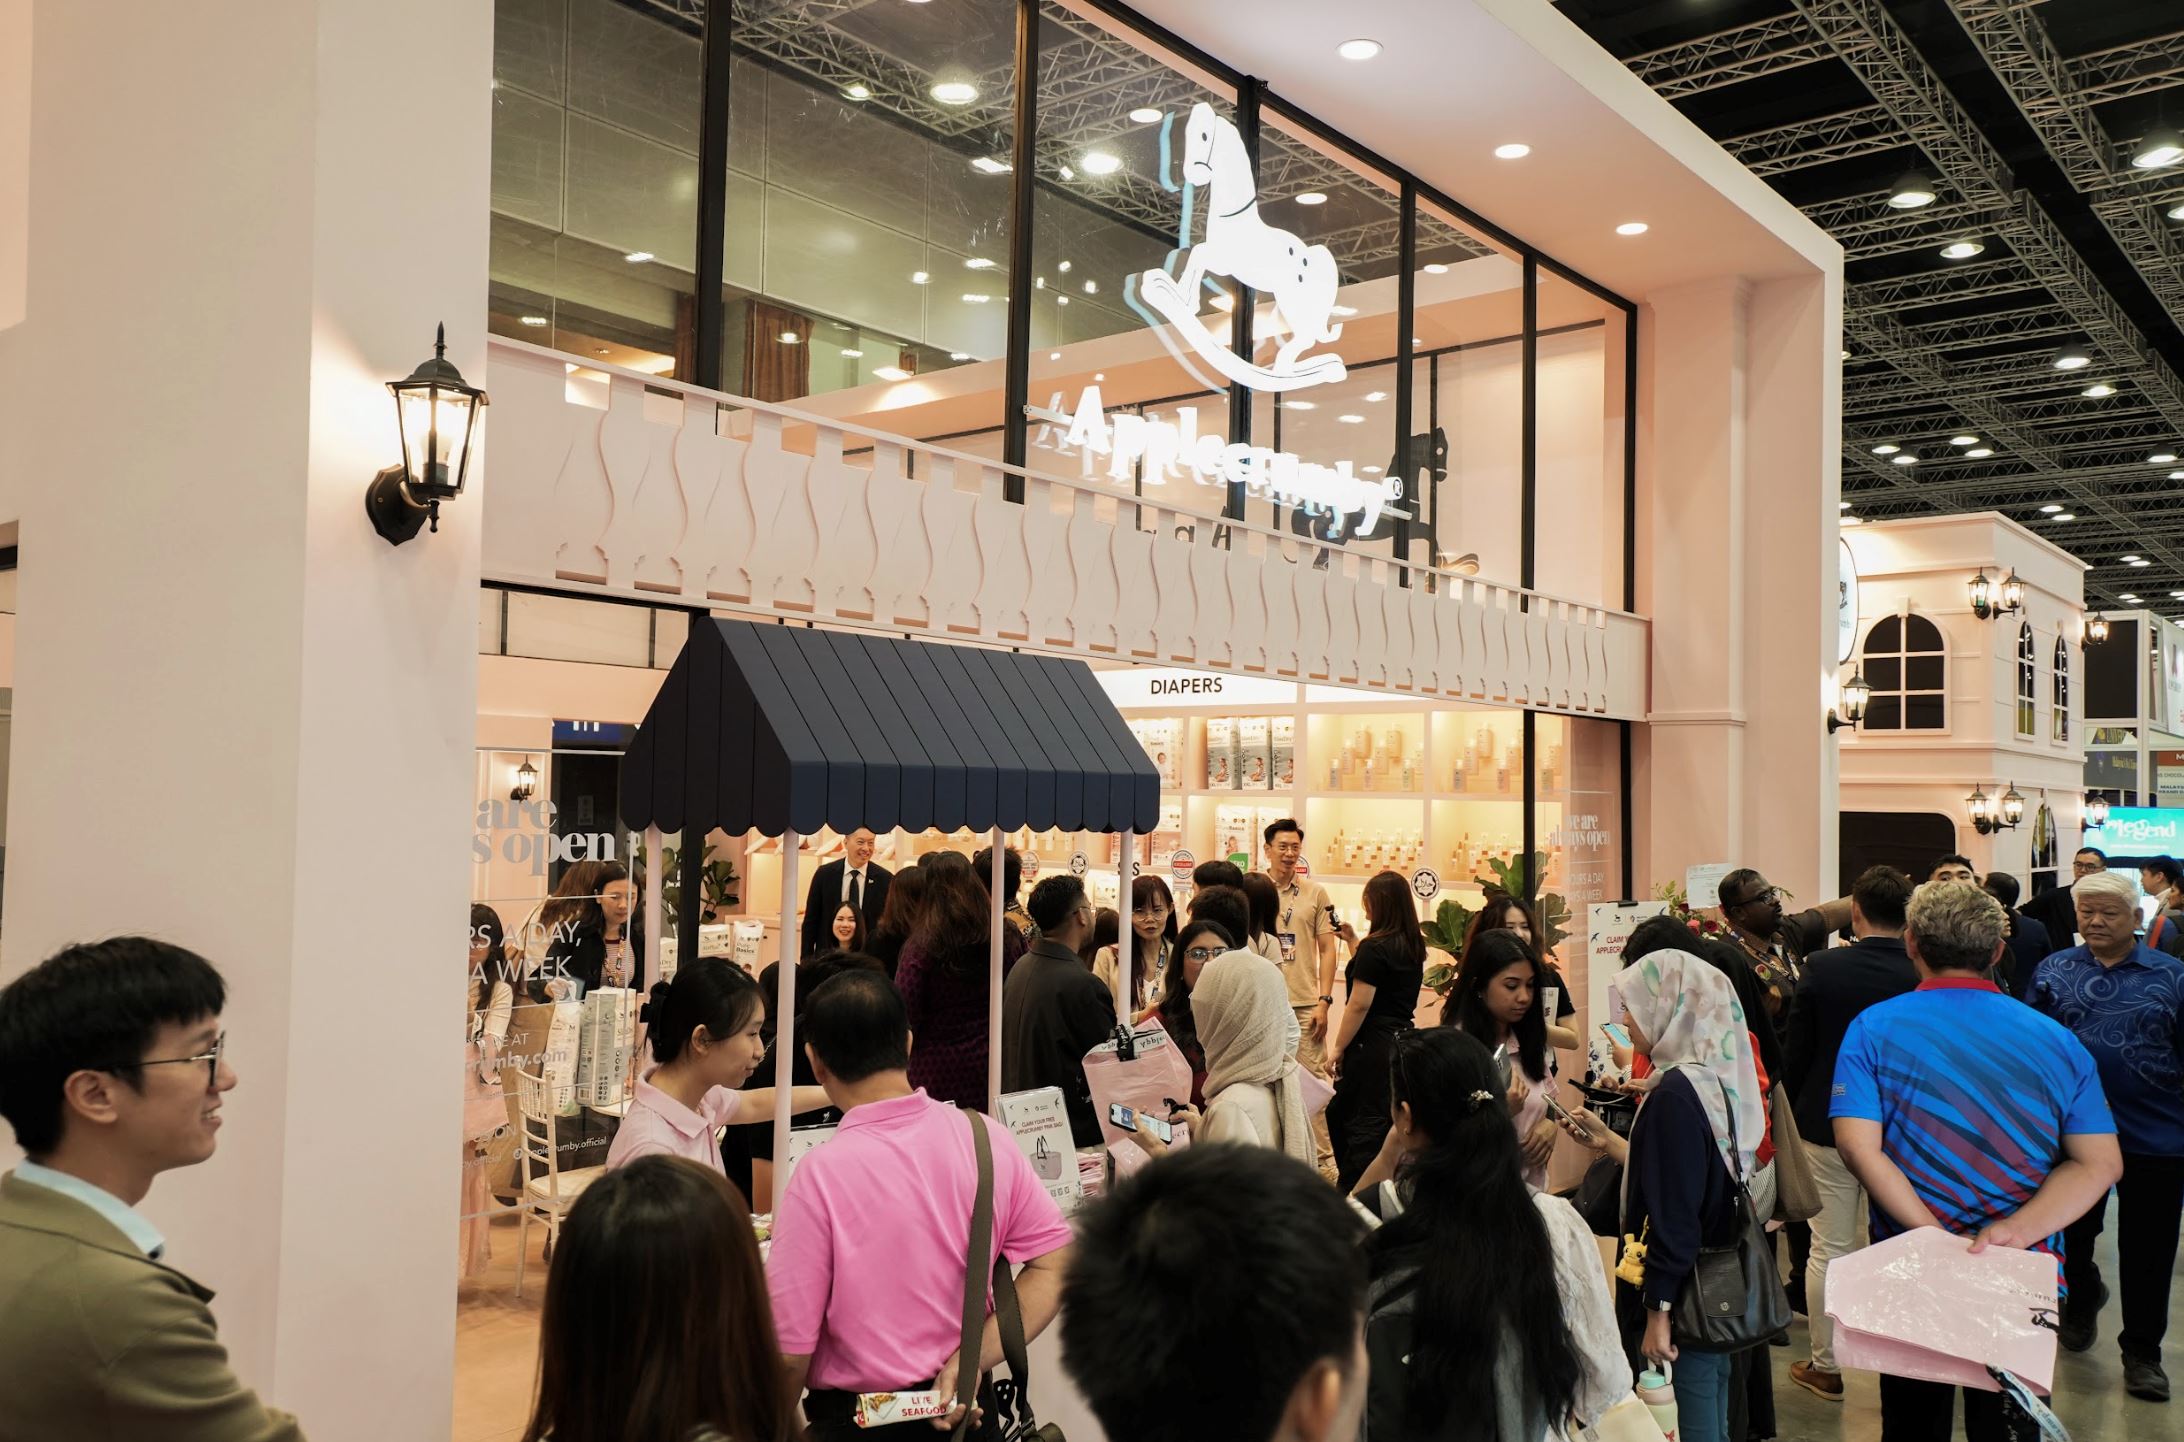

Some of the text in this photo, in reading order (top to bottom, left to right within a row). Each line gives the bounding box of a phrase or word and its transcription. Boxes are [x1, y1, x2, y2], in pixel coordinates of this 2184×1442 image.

[1151, 677, 1223, 695] DIAPERS
[476, 799, 558, 829] are
[1581, 814, 1598, 830] are
[1587, 830, 1610, 852] open
[502, 831, 618, 877] open
[499, 923, 520, 948] A
[1607, 936, 1624, 944] CLAIM
[470, 955, 572, 985] A WEEK
[1021, 1119, 1034, 1127] CLAIM
[901, 1406, 947, 1417] SEAFOOD
